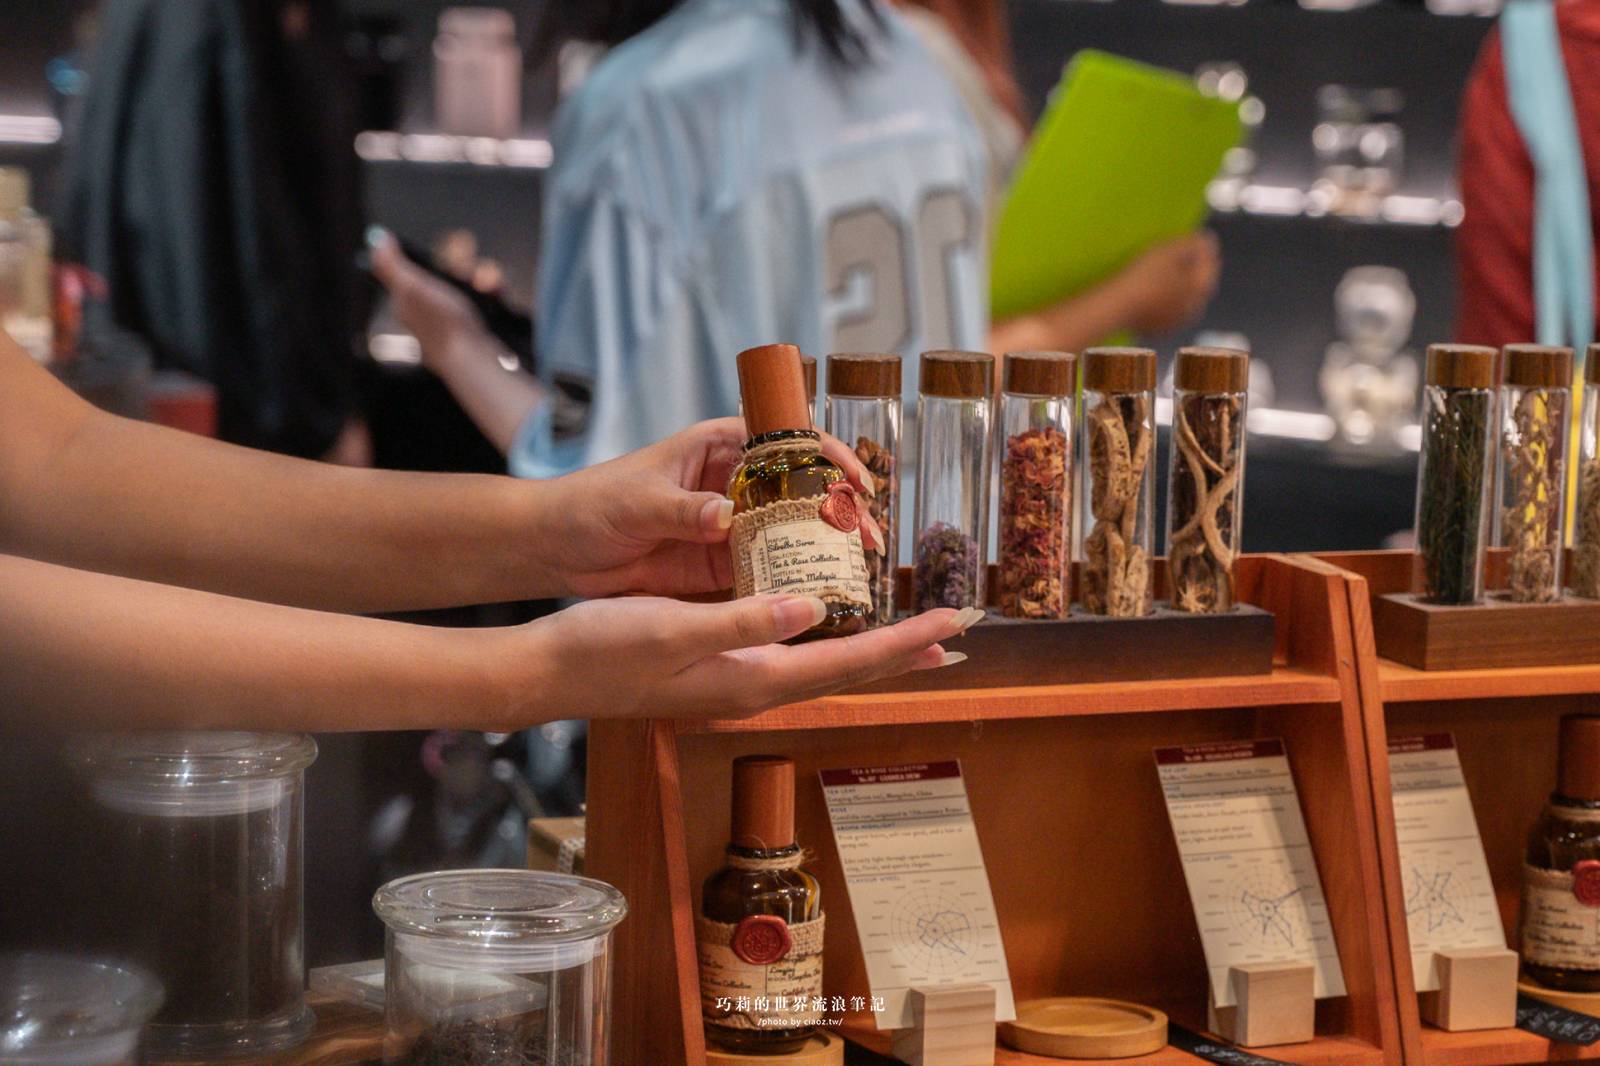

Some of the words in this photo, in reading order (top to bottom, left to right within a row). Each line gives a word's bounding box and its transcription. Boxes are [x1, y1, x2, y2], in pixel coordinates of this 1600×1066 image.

[770, 560, 782, 569] Tea
[783, 559, 789, 567] &
[791, 557, 809, 566] Rose
[809, 554, 840, 563] Collection
[805, 571, 837, 582] Malaysia
[723, 980, 752, 989] Collection
